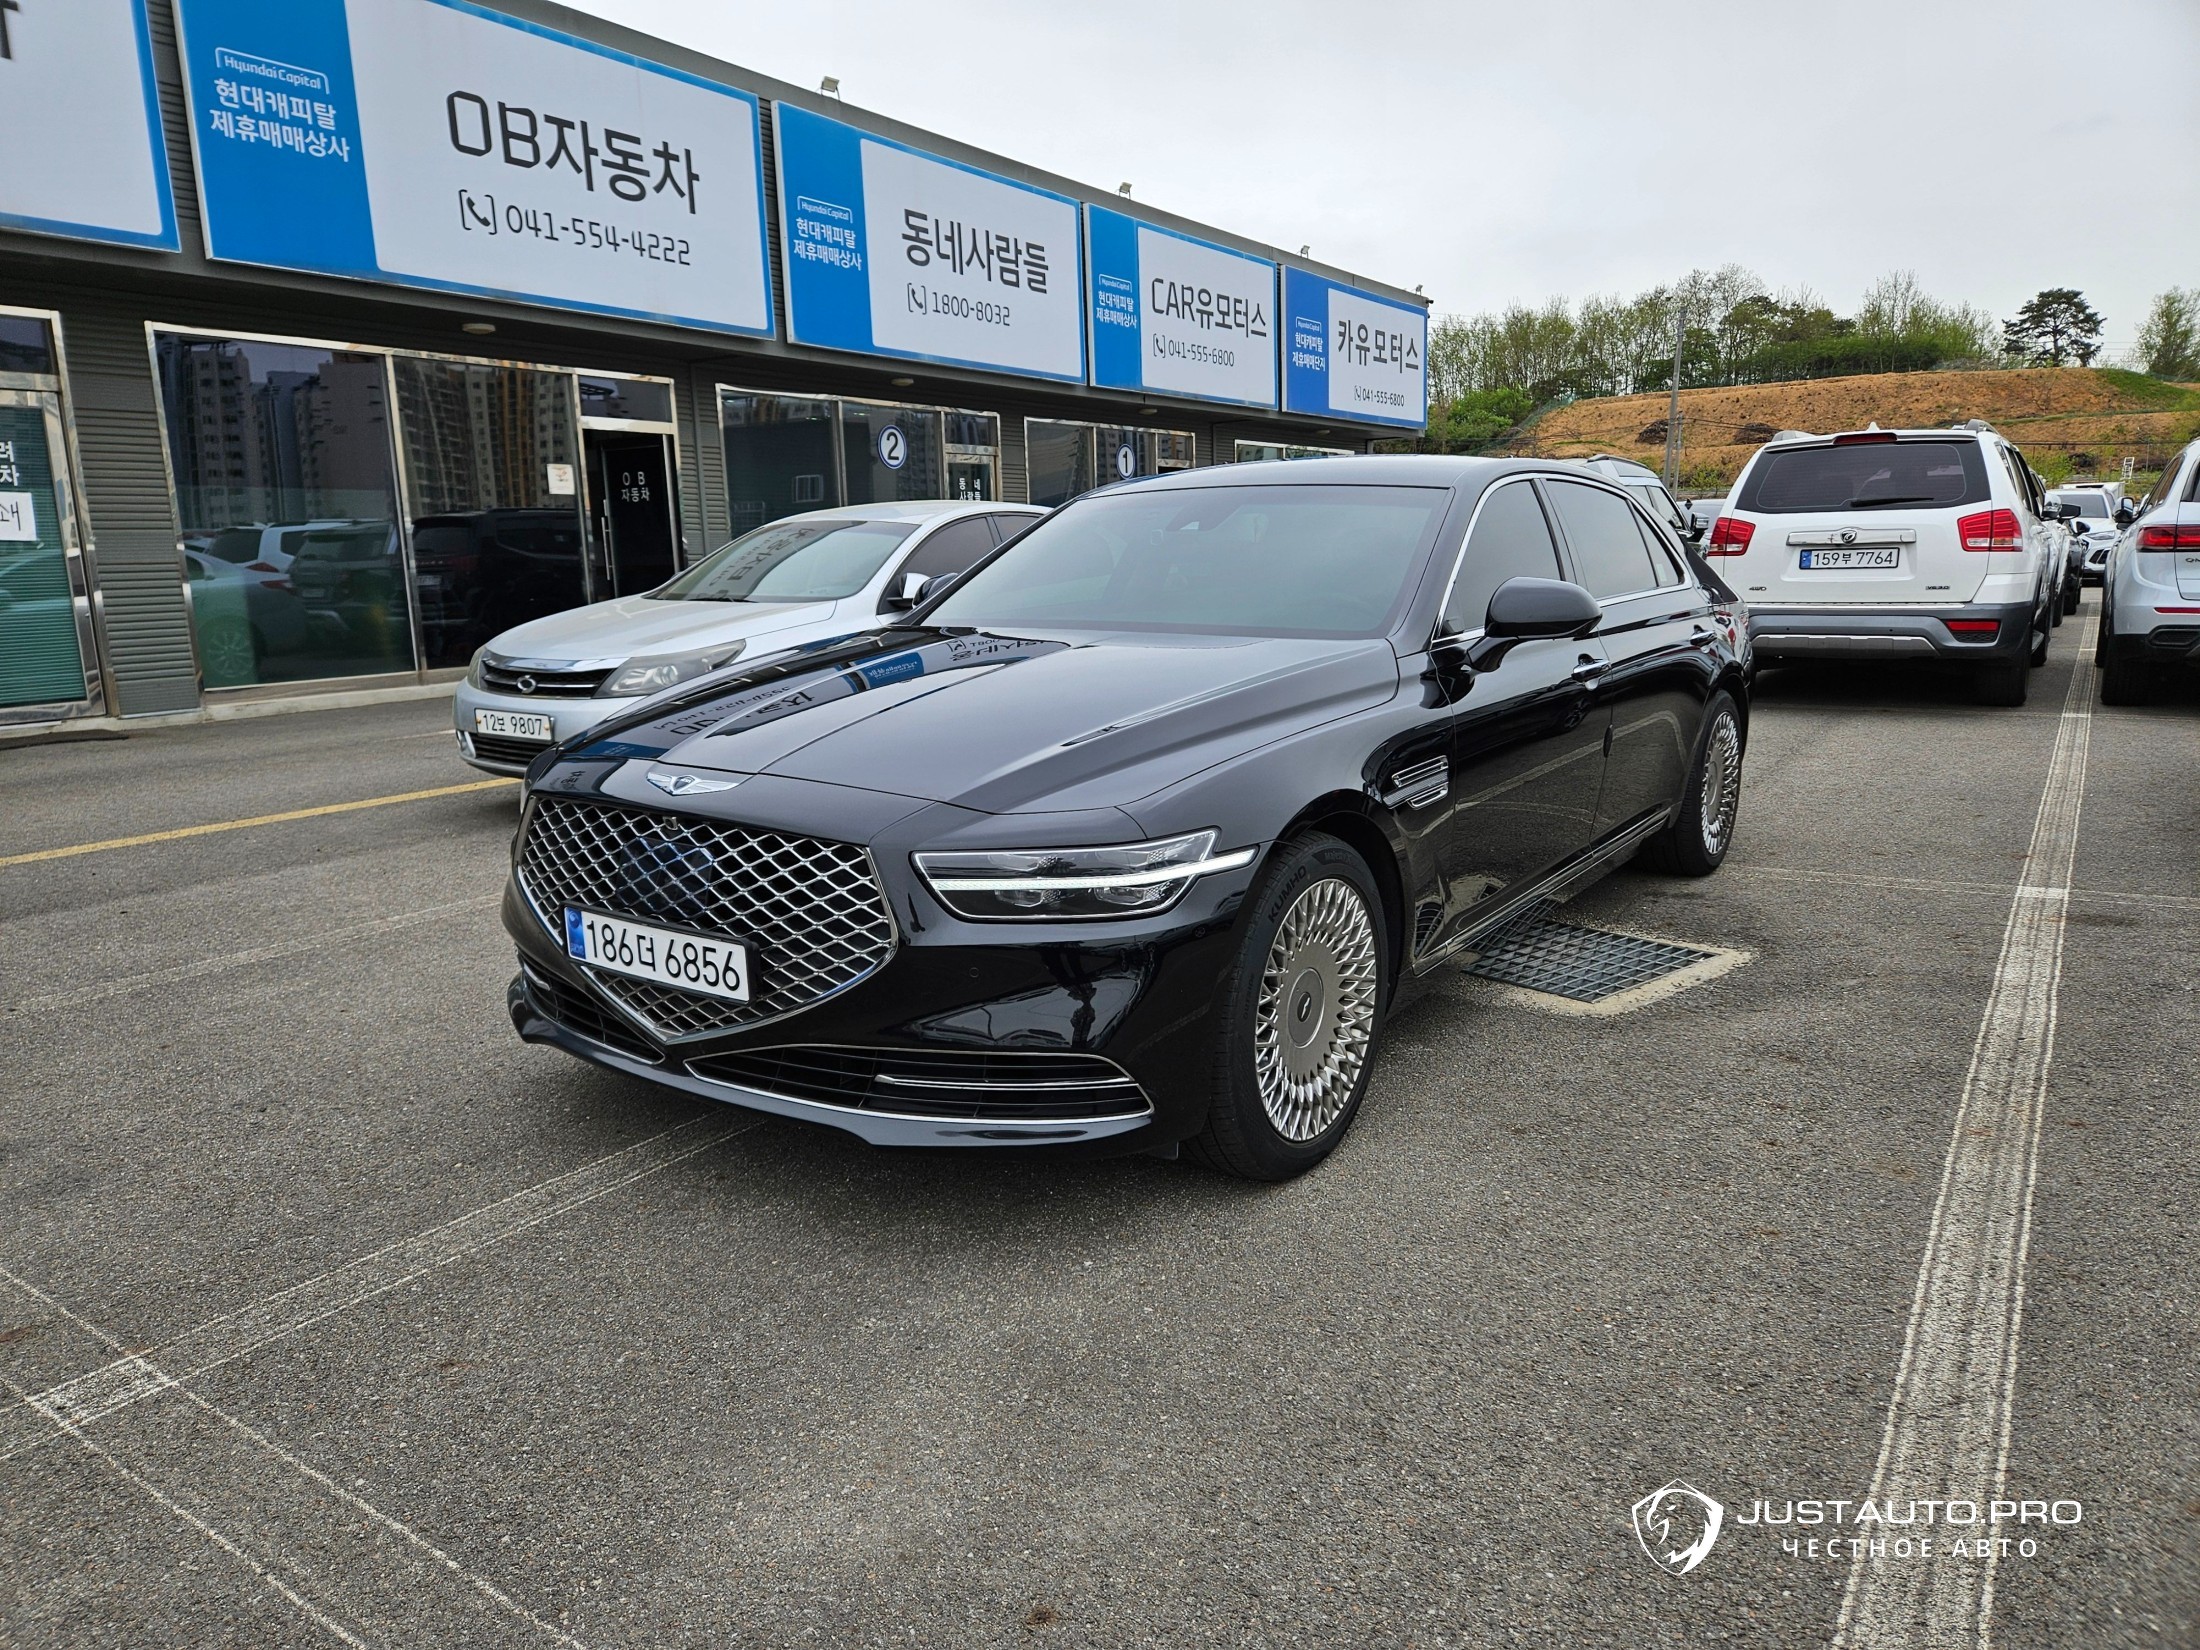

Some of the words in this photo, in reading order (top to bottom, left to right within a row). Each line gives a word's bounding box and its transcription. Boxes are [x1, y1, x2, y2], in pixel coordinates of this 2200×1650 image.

[224, 55, 277, 79] Hyundai
[278, 69, 322, 90] Capital
[214, 78, 337, 131] 현대캐피탈
[209, 109, 350, 163] 제휴매매상사
[446, 90, 700, 215] OB자동차
[505, 204, 692, 267] 041-554-4222
[796, 217, 856, 249] 현대캐피탈
[793, 239, 862, 271] 제휴매매상사
[901, 208, 1049, 294] 동네사람들
[932, 292, 1011, 327] 1800-8032
[1098, 290, 1134, 312] 현대캐피탈
[1151, 277, 1267, 338] CAR유모터스
[1096, 307, 1137, 329] 제휴매매상사
[1168, 339, 1235, 368] 041-555-6800
[1295, 332, 1323, 353] 현대캐피탈
[1337, 319, 1419, 374] 카유모터스
[1362, 389, 1405, 408] 041-555-6800
[885, 430, 900, 461] 2
[1122, 451, 1130, 474] 1
[621, 487, 650, 503] 자동차
[1813, 552, 1852, 566] 159부
[1856, 551, 1893, 565] 7764
[483, 713, 506, 732] 12보
[510, 716, 542, 736] 9807
[1268, 865, 1307, 923] KUMHO
[586, 919, 657, 972] 186더
[665, 938, 741, 992] 6856
